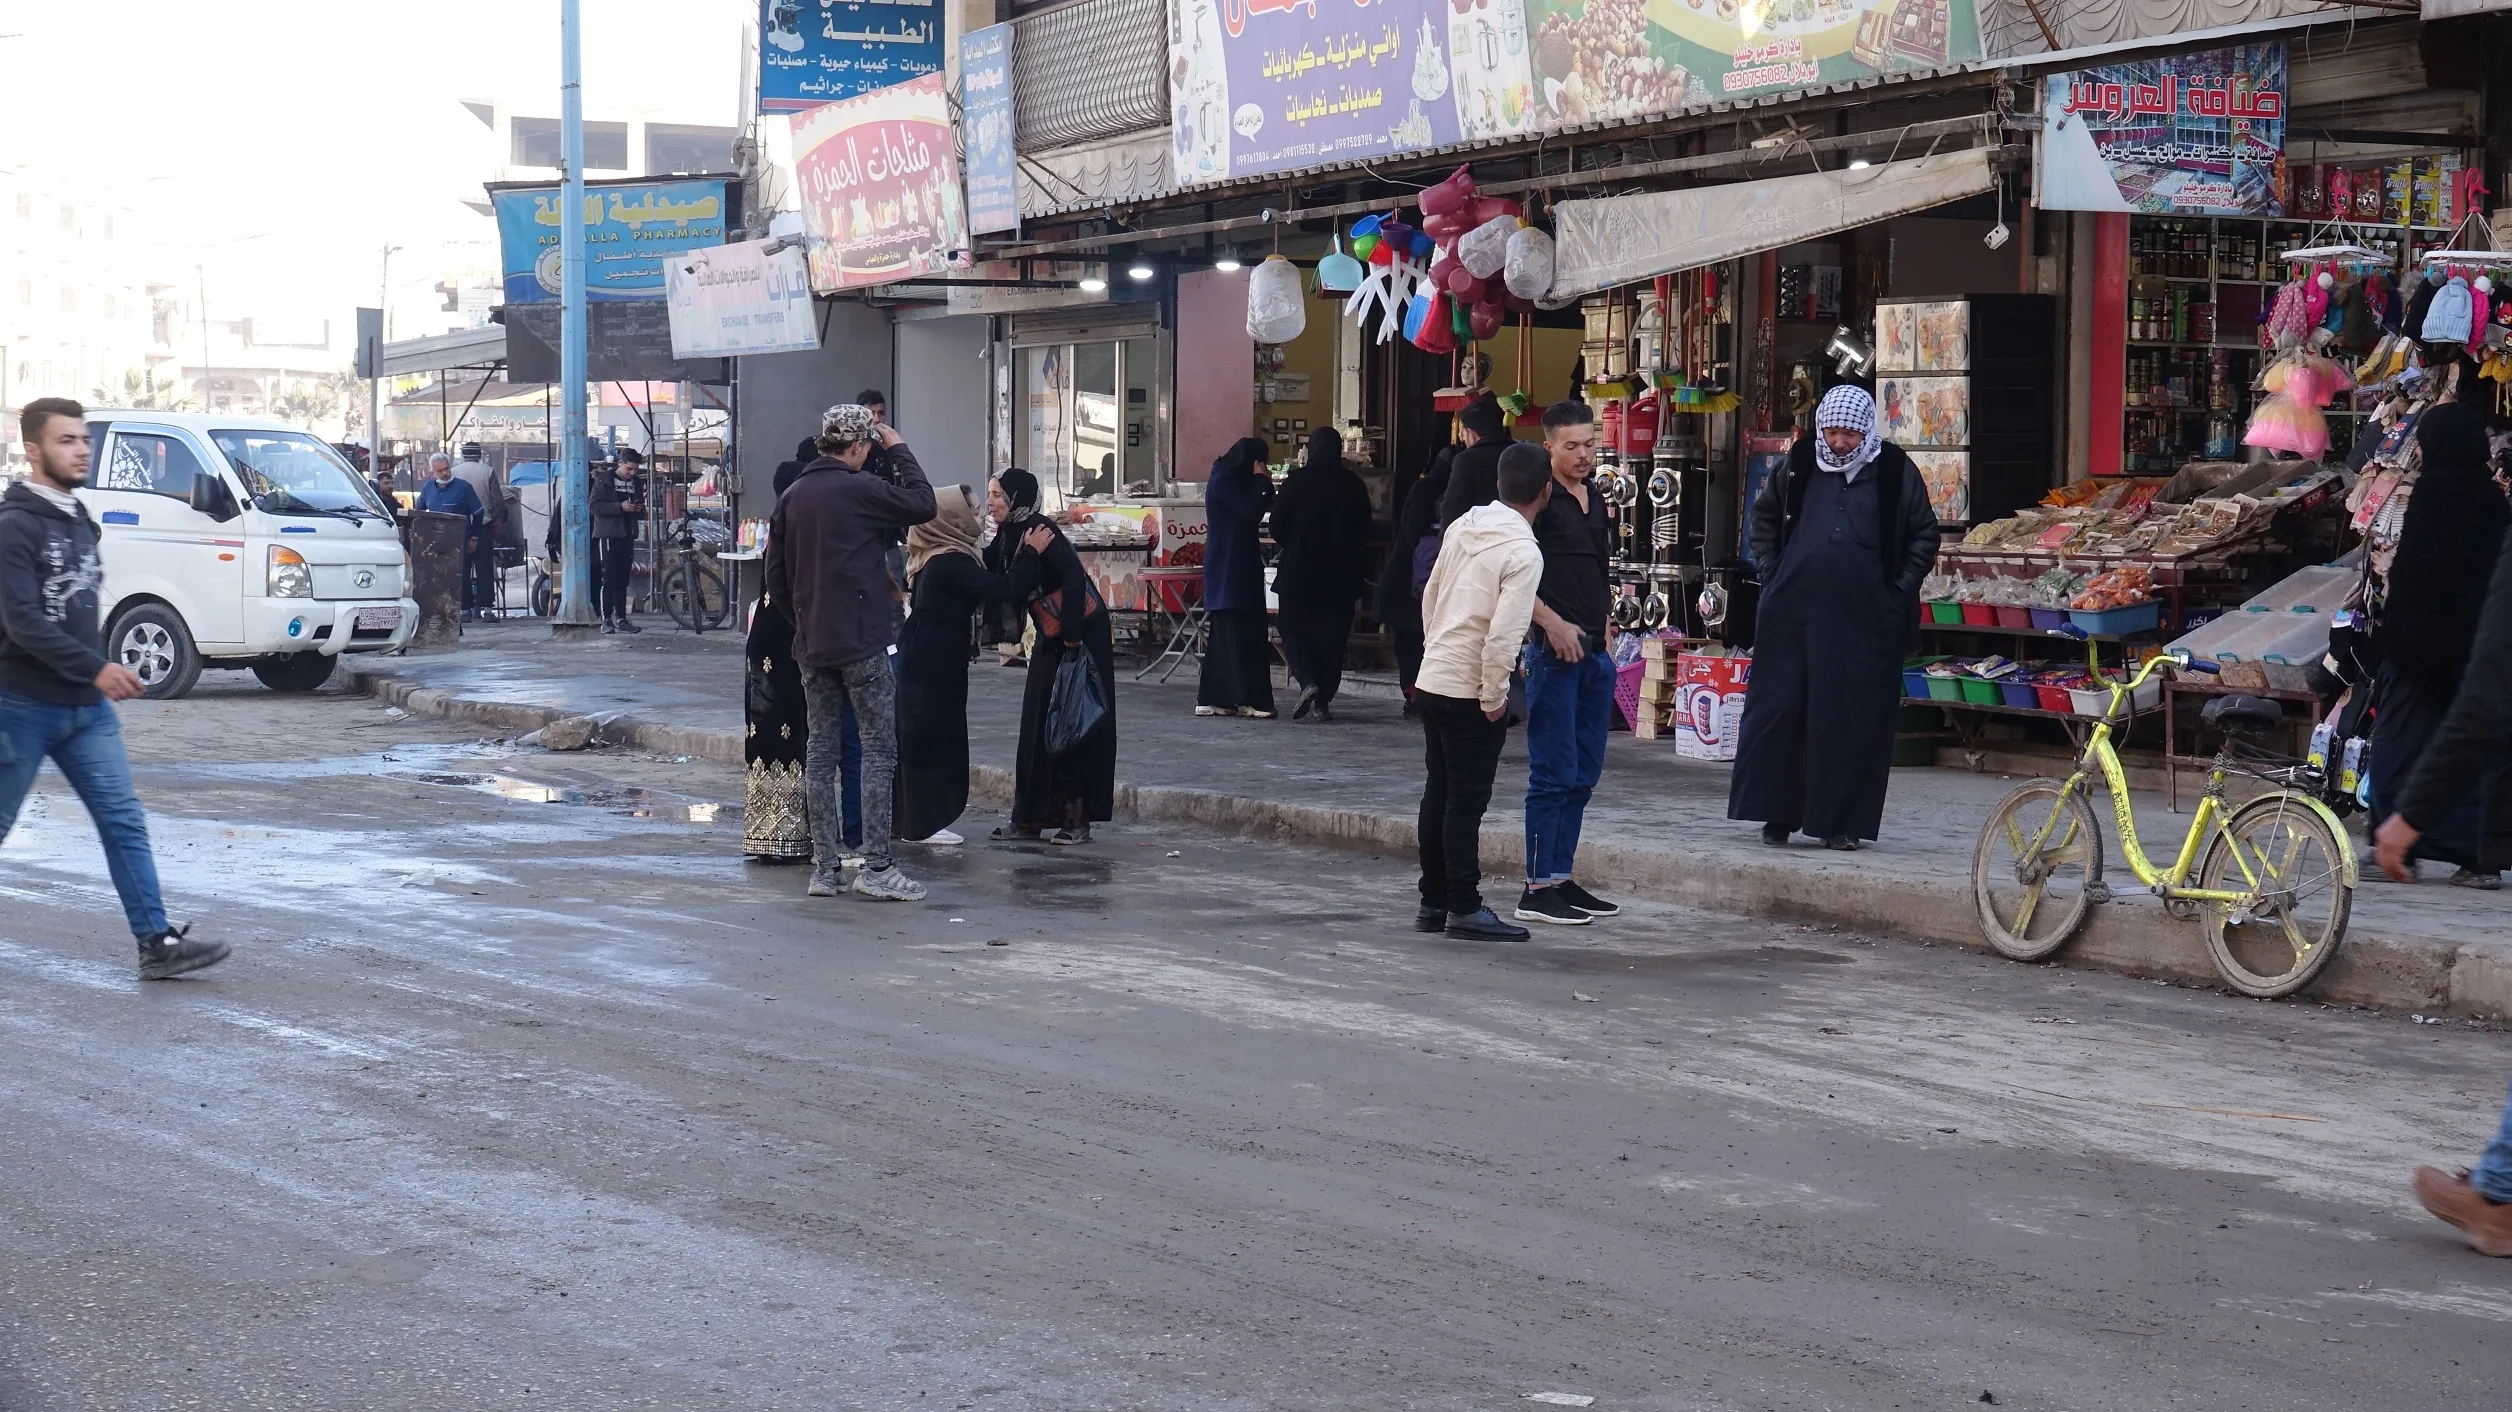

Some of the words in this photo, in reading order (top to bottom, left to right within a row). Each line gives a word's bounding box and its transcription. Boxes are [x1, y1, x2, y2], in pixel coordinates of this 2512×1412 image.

[822, 12, 934, 51] الطبية
[1368, 16, 1401, 67] أواني
[767, 53, 808, 70] مصليات
[1262, 40, 1318, 84] كهربائيات
[1325, 32, 1366, 73] منزلية
[819, 54, 851, 73] حيوية
[854, 58, 888, 71] كيمياء
[900, 59, 938, 74] دمويات
[799, 76, 845, 96] جراثيم
[1723, 63, 1788, 92] 0930756082
[2060, 73, 2177, 124] العروس
[2187, 75, 2282, 131] ضيافة
[1285, 90, 1327, 129] نحاسيات
[866, 122, 931, 187] مثلجات
[2098, 141, 2114, 160] بن
[2123, 143, 2148, 163] عسل
[2156, 143, 2182, 163] موالح
[2190, 144, 2236, 163] مكسرات
[2246, 145, 2277, 164] ضيافة
[811, 134, 864, 203] الحمزة
[2199, 182, 2217, 195] كرمو
[2412, 178, 2437, 193] Truffle
[2172, 195, 2221, 206] 0930756082
[609, 192, 719, 230] صيدلية
[633, 226, 722, 240] PHARMACY
[605, 266, 650, 281] تجميل
[721, 315, 750, 328] EXCHANGE
[754, 311, 785, 325] TRANSFERS
[1688, 659, 1712, 677] جنى
[1725, 695, 1745, 704] jana
